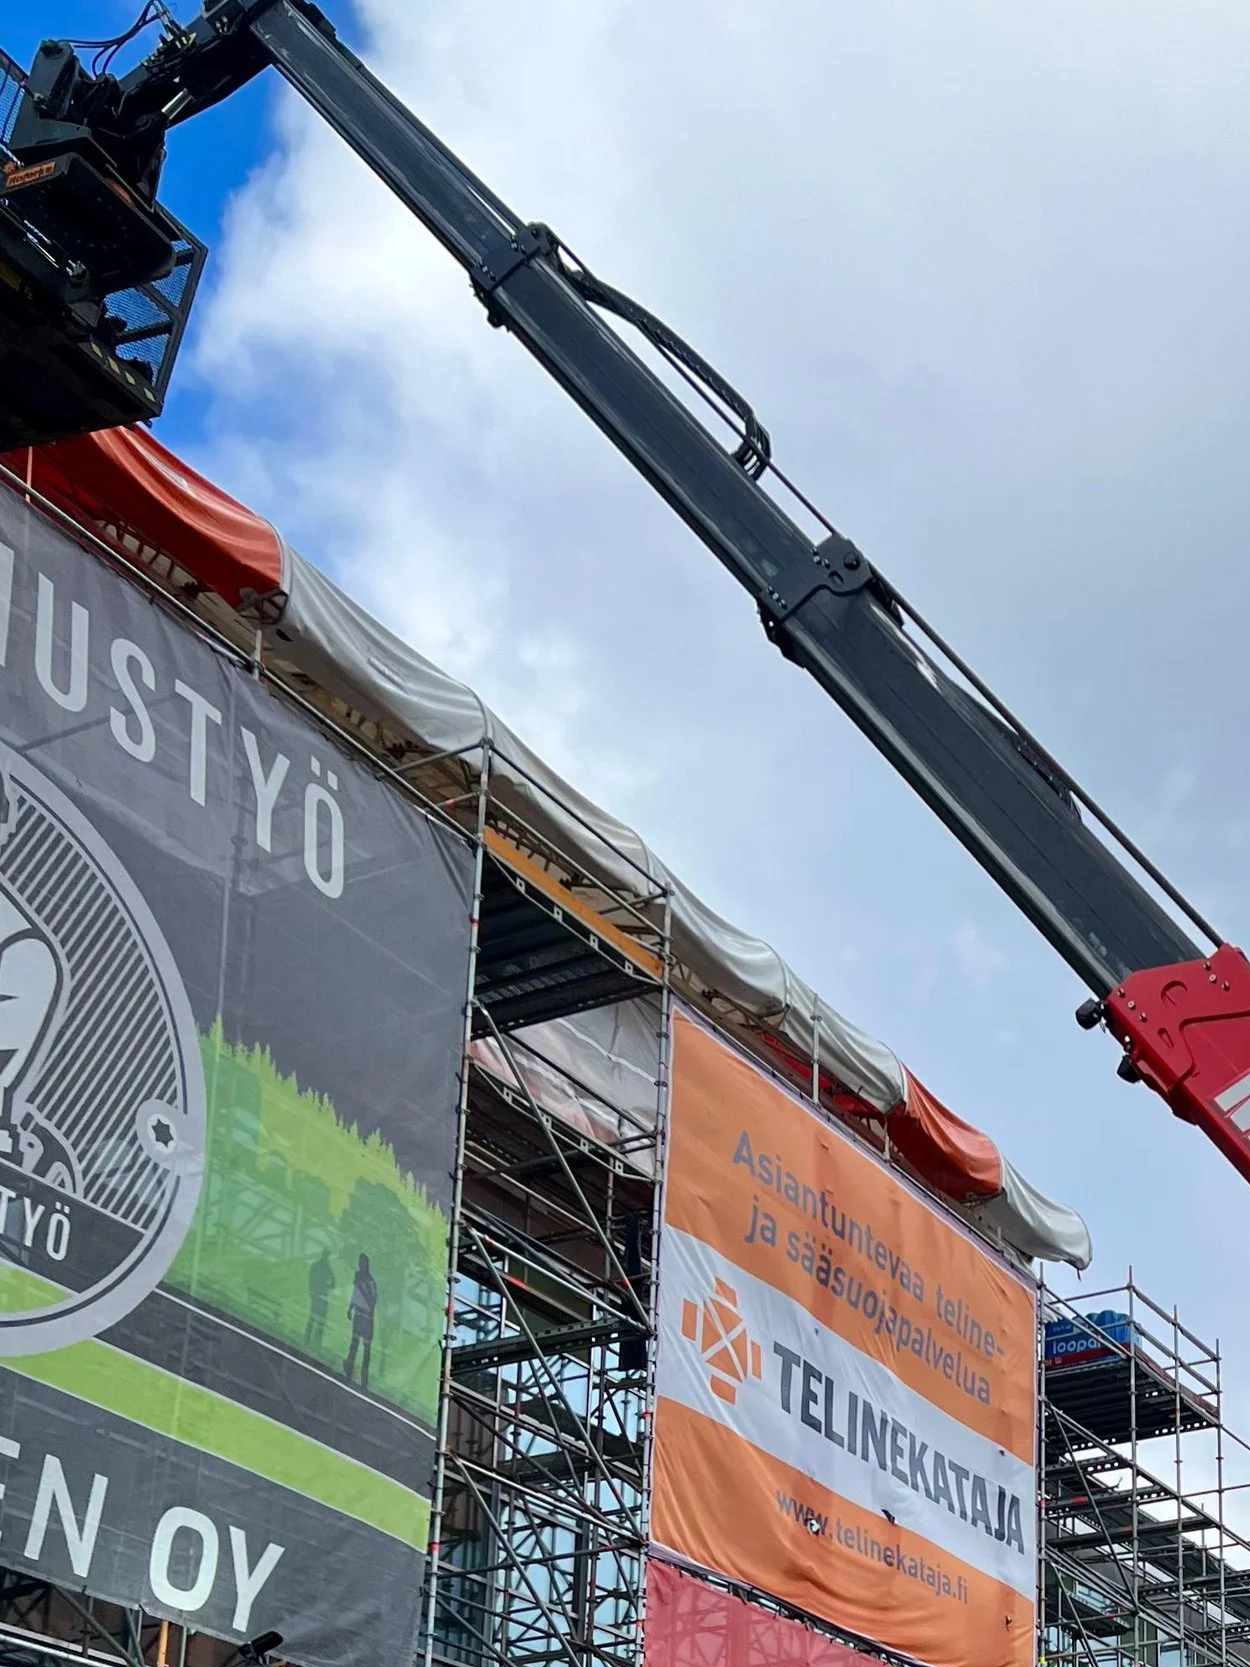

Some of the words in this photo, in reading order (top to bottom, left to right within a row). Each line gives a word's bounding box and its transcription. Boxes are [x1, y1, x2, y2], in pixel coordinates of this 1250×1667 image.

[733, 1131, 925, 1303] Asiantuntevaa
[936, 1284, 1006, 1358] teline-
[745, 1195, 777, 1247] ja
[786, 1228, 991, 1407] sääsuojapalvelua
[773, 1340, 1025, 1556] TELINEKATAJA
[776, 1488, 968, 1604] www.telinekataja.fi
[148, 1505, 285, 1632] OY
